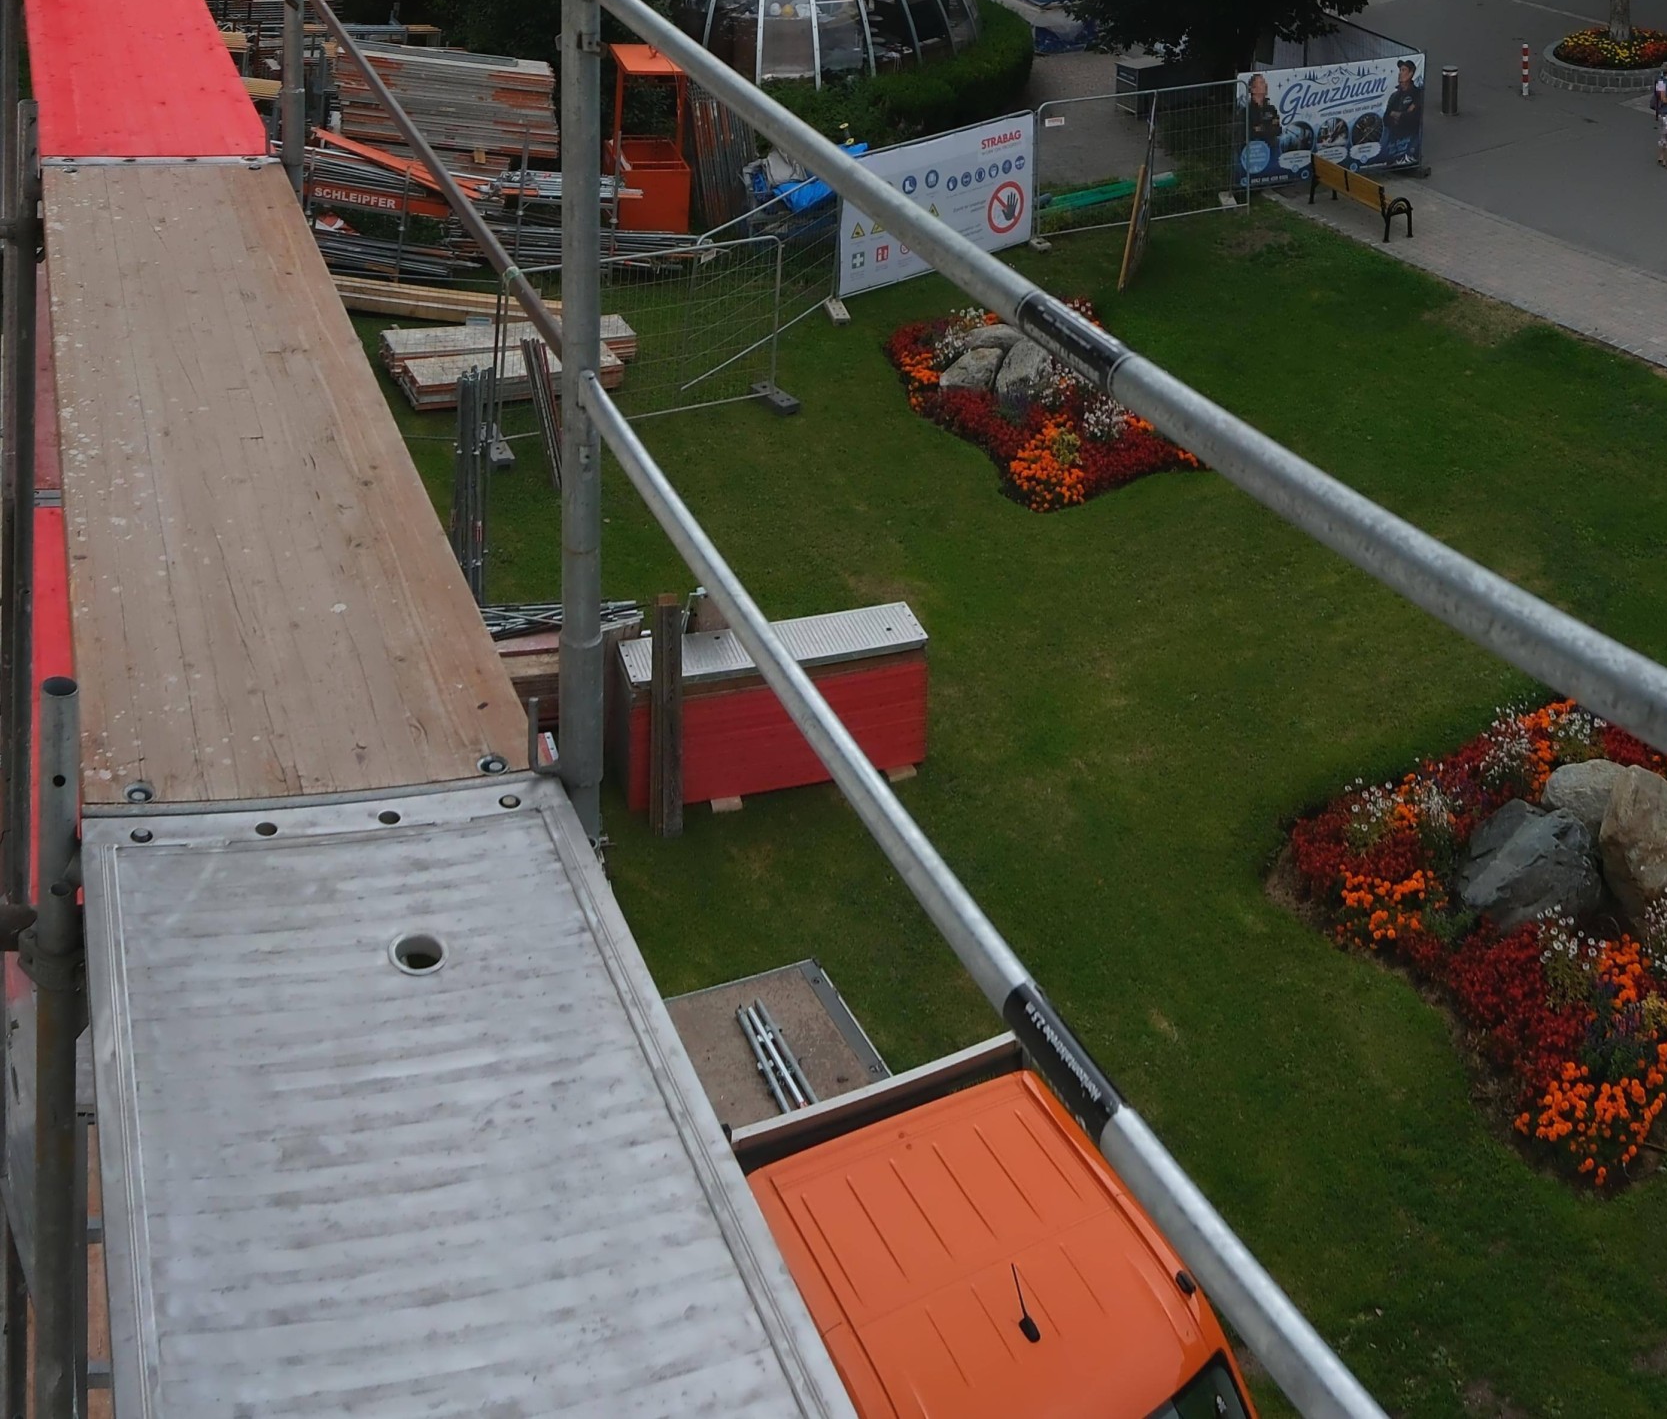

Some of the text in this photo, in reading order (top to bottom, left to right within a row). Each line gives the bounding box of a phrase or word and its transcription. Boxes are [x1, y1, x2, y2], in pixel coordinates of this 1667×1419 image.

[1279, 76, 1388, 125] Glanzbuam
[981, 130, 1021, 149] STRABAG
[315, 187, 395, 208] SCHLEIPFER
